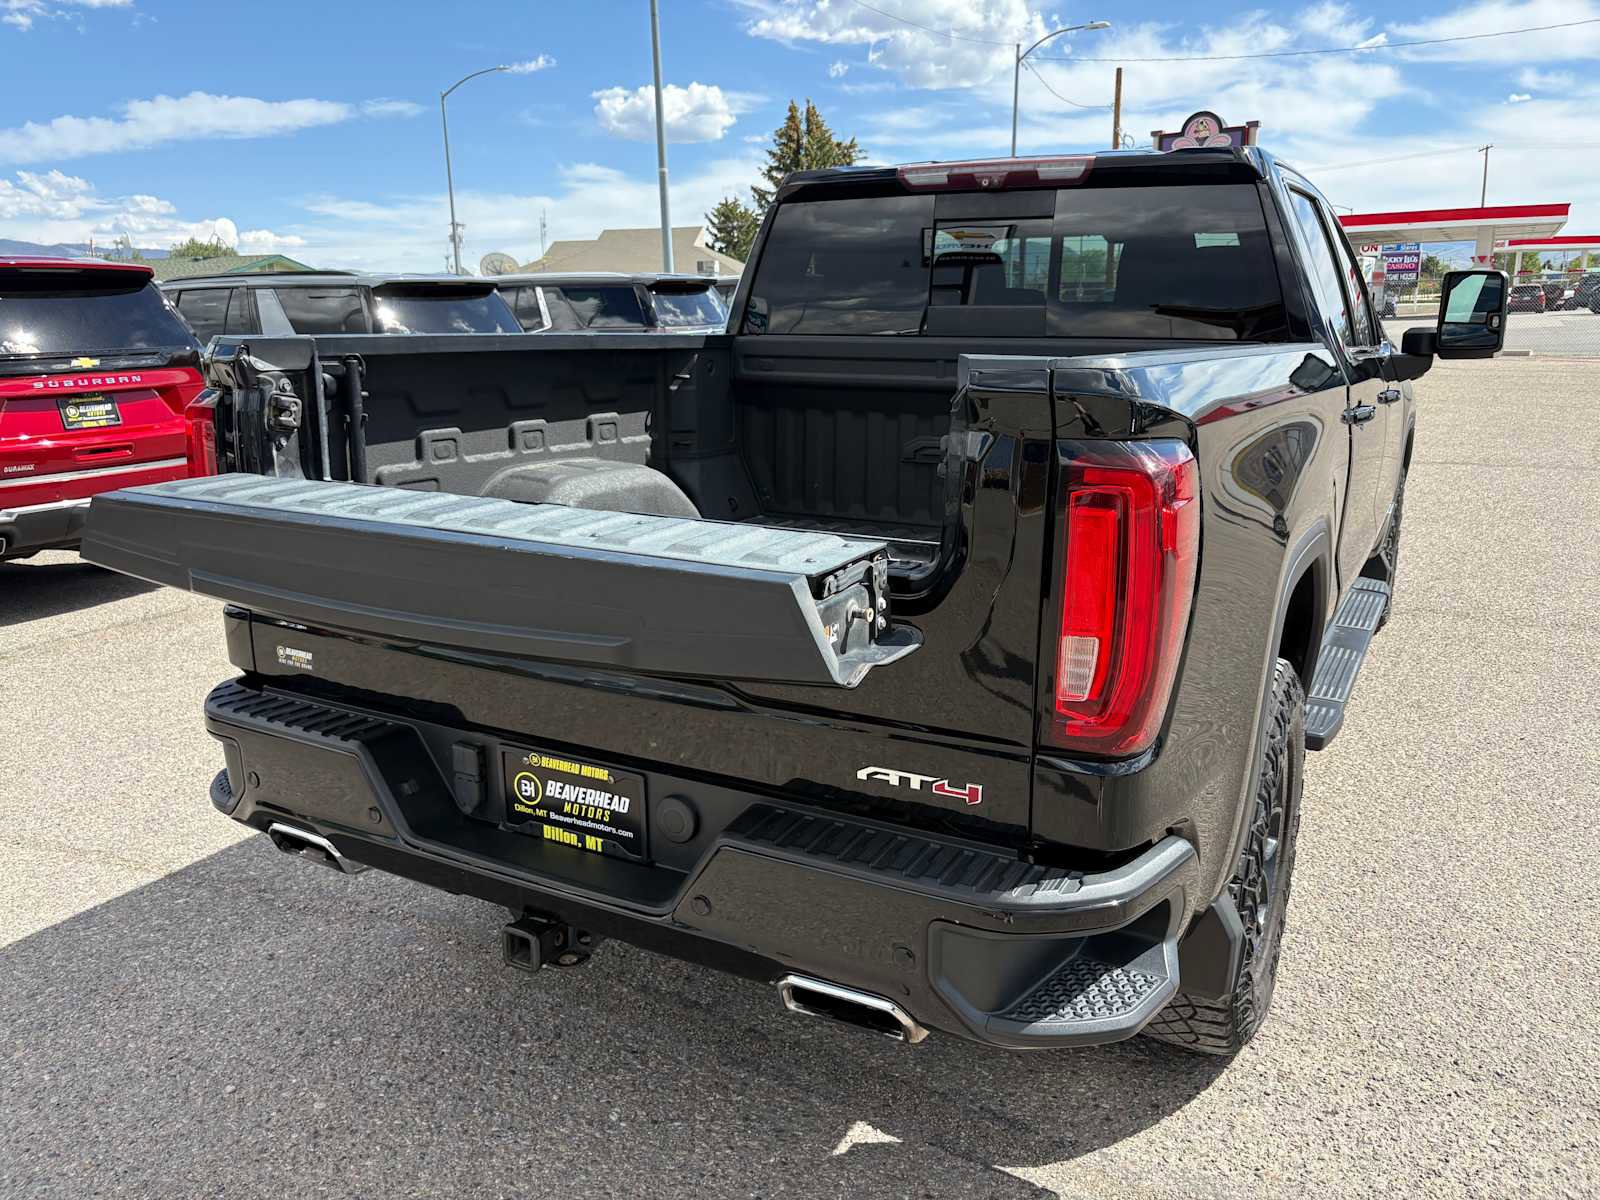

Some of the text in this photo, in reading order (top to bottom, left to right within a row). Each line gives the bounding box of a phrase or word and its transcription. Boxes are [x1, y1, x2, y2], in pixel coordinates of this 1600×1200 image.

[1385, 262, 1416, 271] CASINO
[32, 375, 142, 389] SUBURBAN
[3, 463, 35, 473] DURAMAX
[541, 756, 581, 775] BEAVERHEAD
[580, 764, 609, 781] MOTORS
[545, 780, 630, 814] BEAVERHEAD
[856, 766, 982, 805] AT4
[563, 801, 611, 822] MOTORS
[549, 811, 634, 839] Beaverheadmotors.com
[543, 824, 604, 852] Dillon, MT
